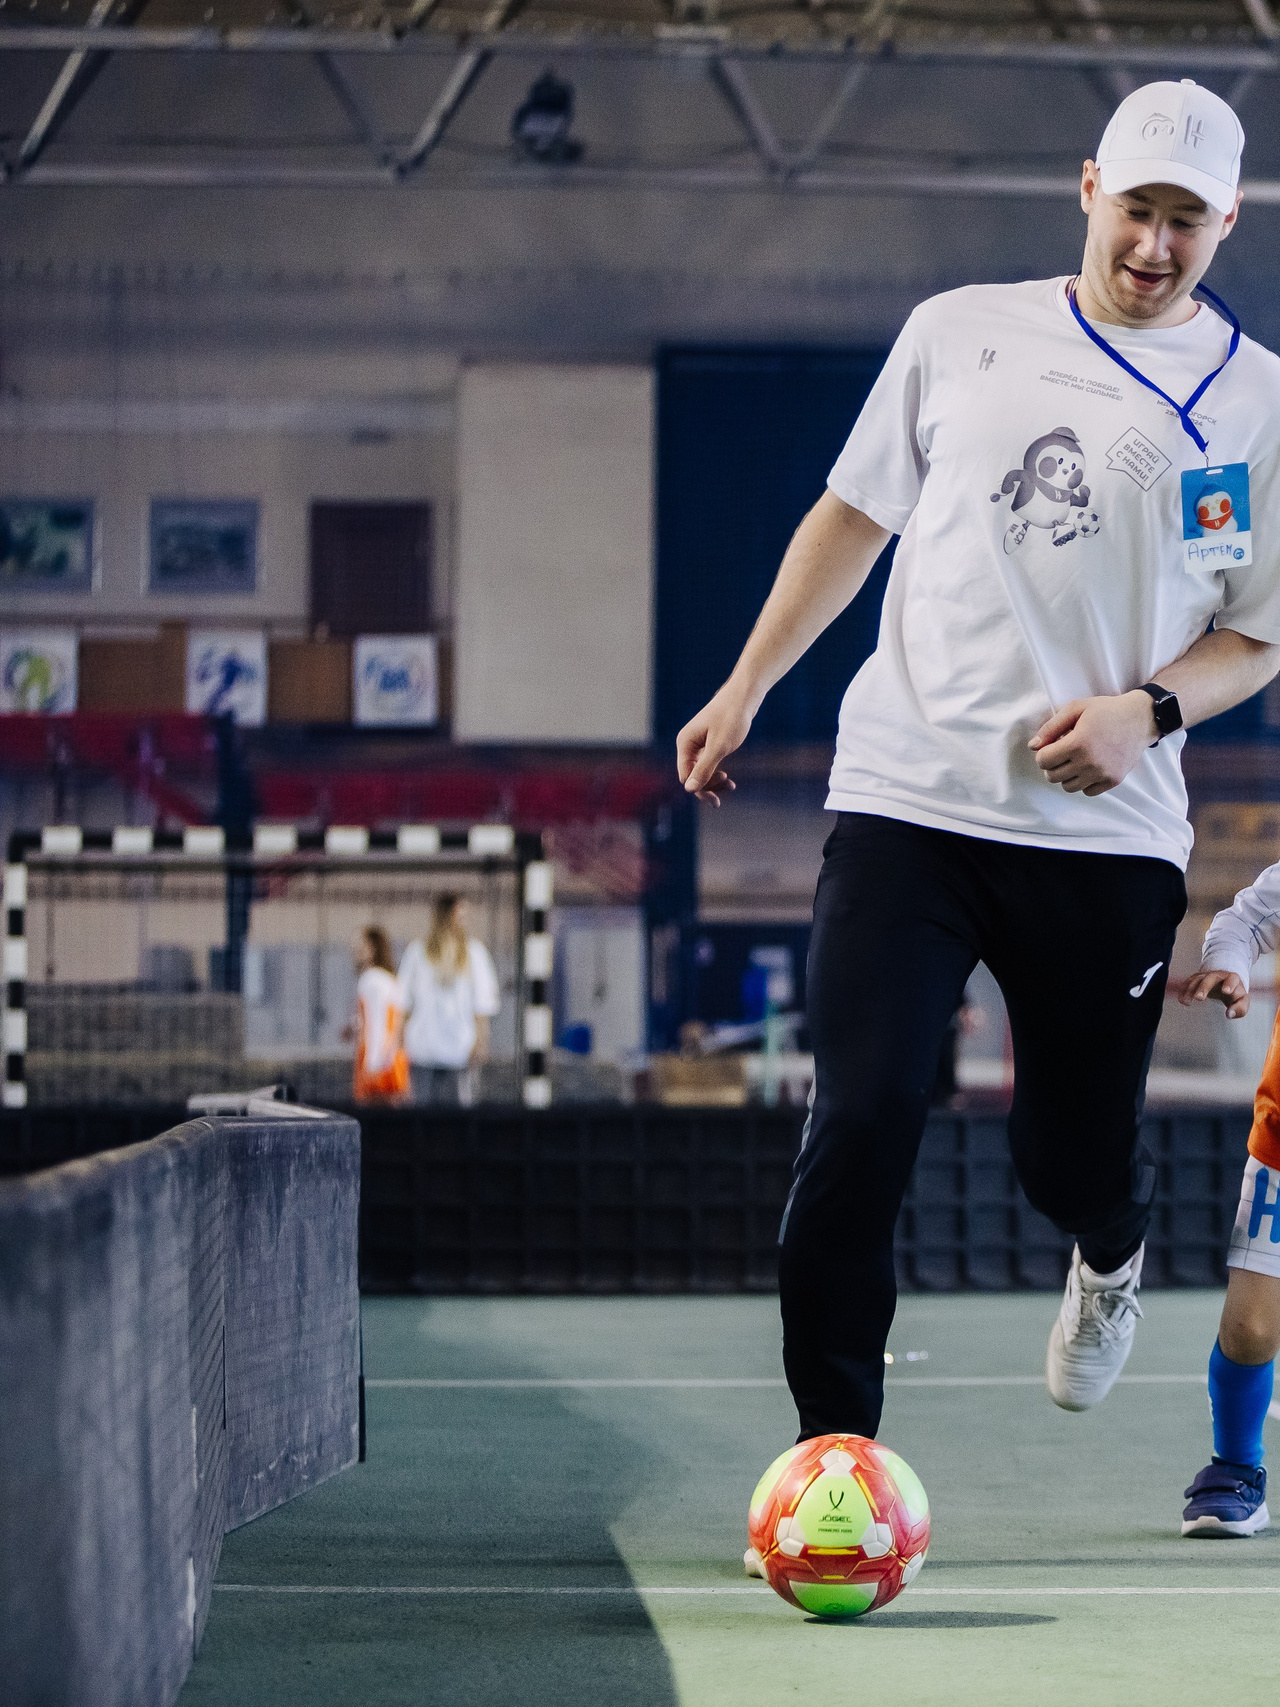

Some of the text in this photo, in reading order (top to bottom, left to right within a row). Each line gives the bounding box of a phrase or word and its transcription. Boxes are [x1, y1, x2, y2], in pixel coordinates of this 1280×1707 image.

[1039, 374, 1124, 401] ВМЕСТЕ МЫ СИЛЬНЕЕ!
[1048, 369, 1078, 383] ВПЕРЁД
[1086, 379, 1121, 394] ПОБЕДЕ!
[1123, 443, 1156, 474] ВМЕСТЕ
[1132, 438, 1160, 464] ИГРАЙ
[1115, 450, 1150, 482] С НАМИ!
